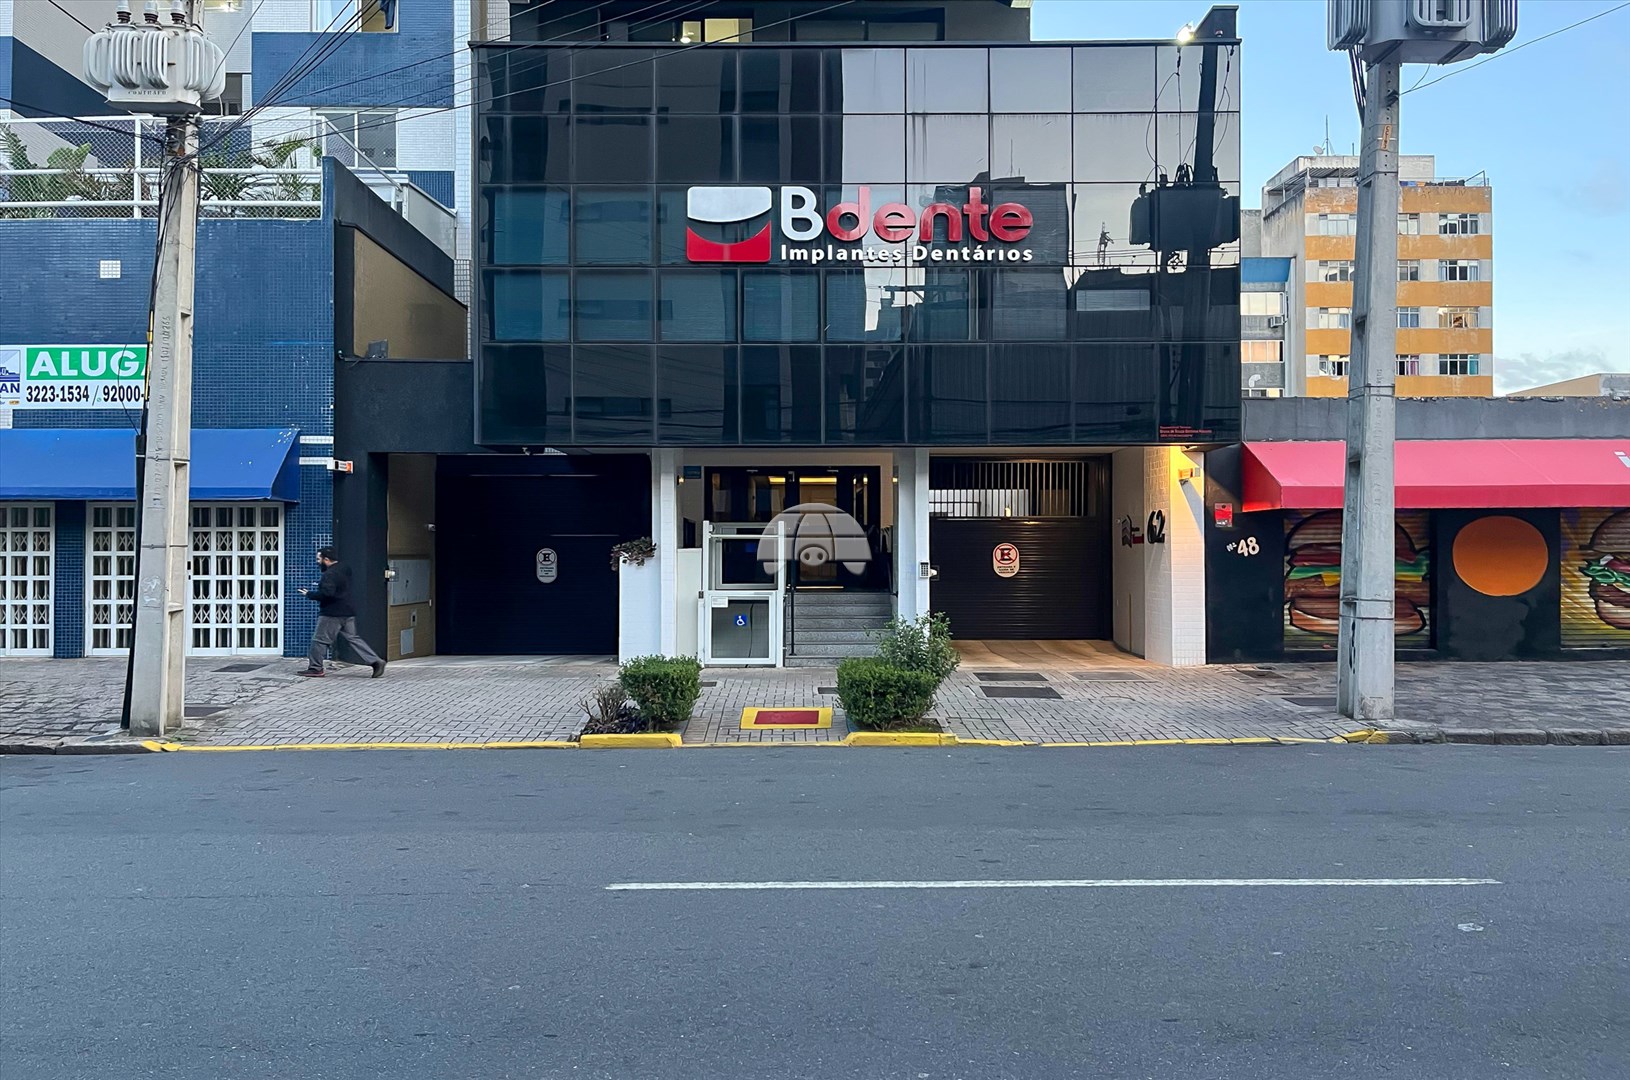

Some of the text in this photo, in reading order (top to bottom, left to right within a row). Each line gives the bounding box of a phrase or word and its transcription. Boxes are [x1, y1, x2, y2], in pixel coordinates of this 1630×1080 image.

[781, 186, 1034, 242] Bdente
[781, 245, 1034, 265] Implantes Dentários
[30, 350, 146, 377] ALUG
[26, 385, 90, 403] 3223-1534
[103, 385, 150, 403] 92000-
[1147, 509, 1165, 544] 62
[1237, 536, 1260, 557] 48
